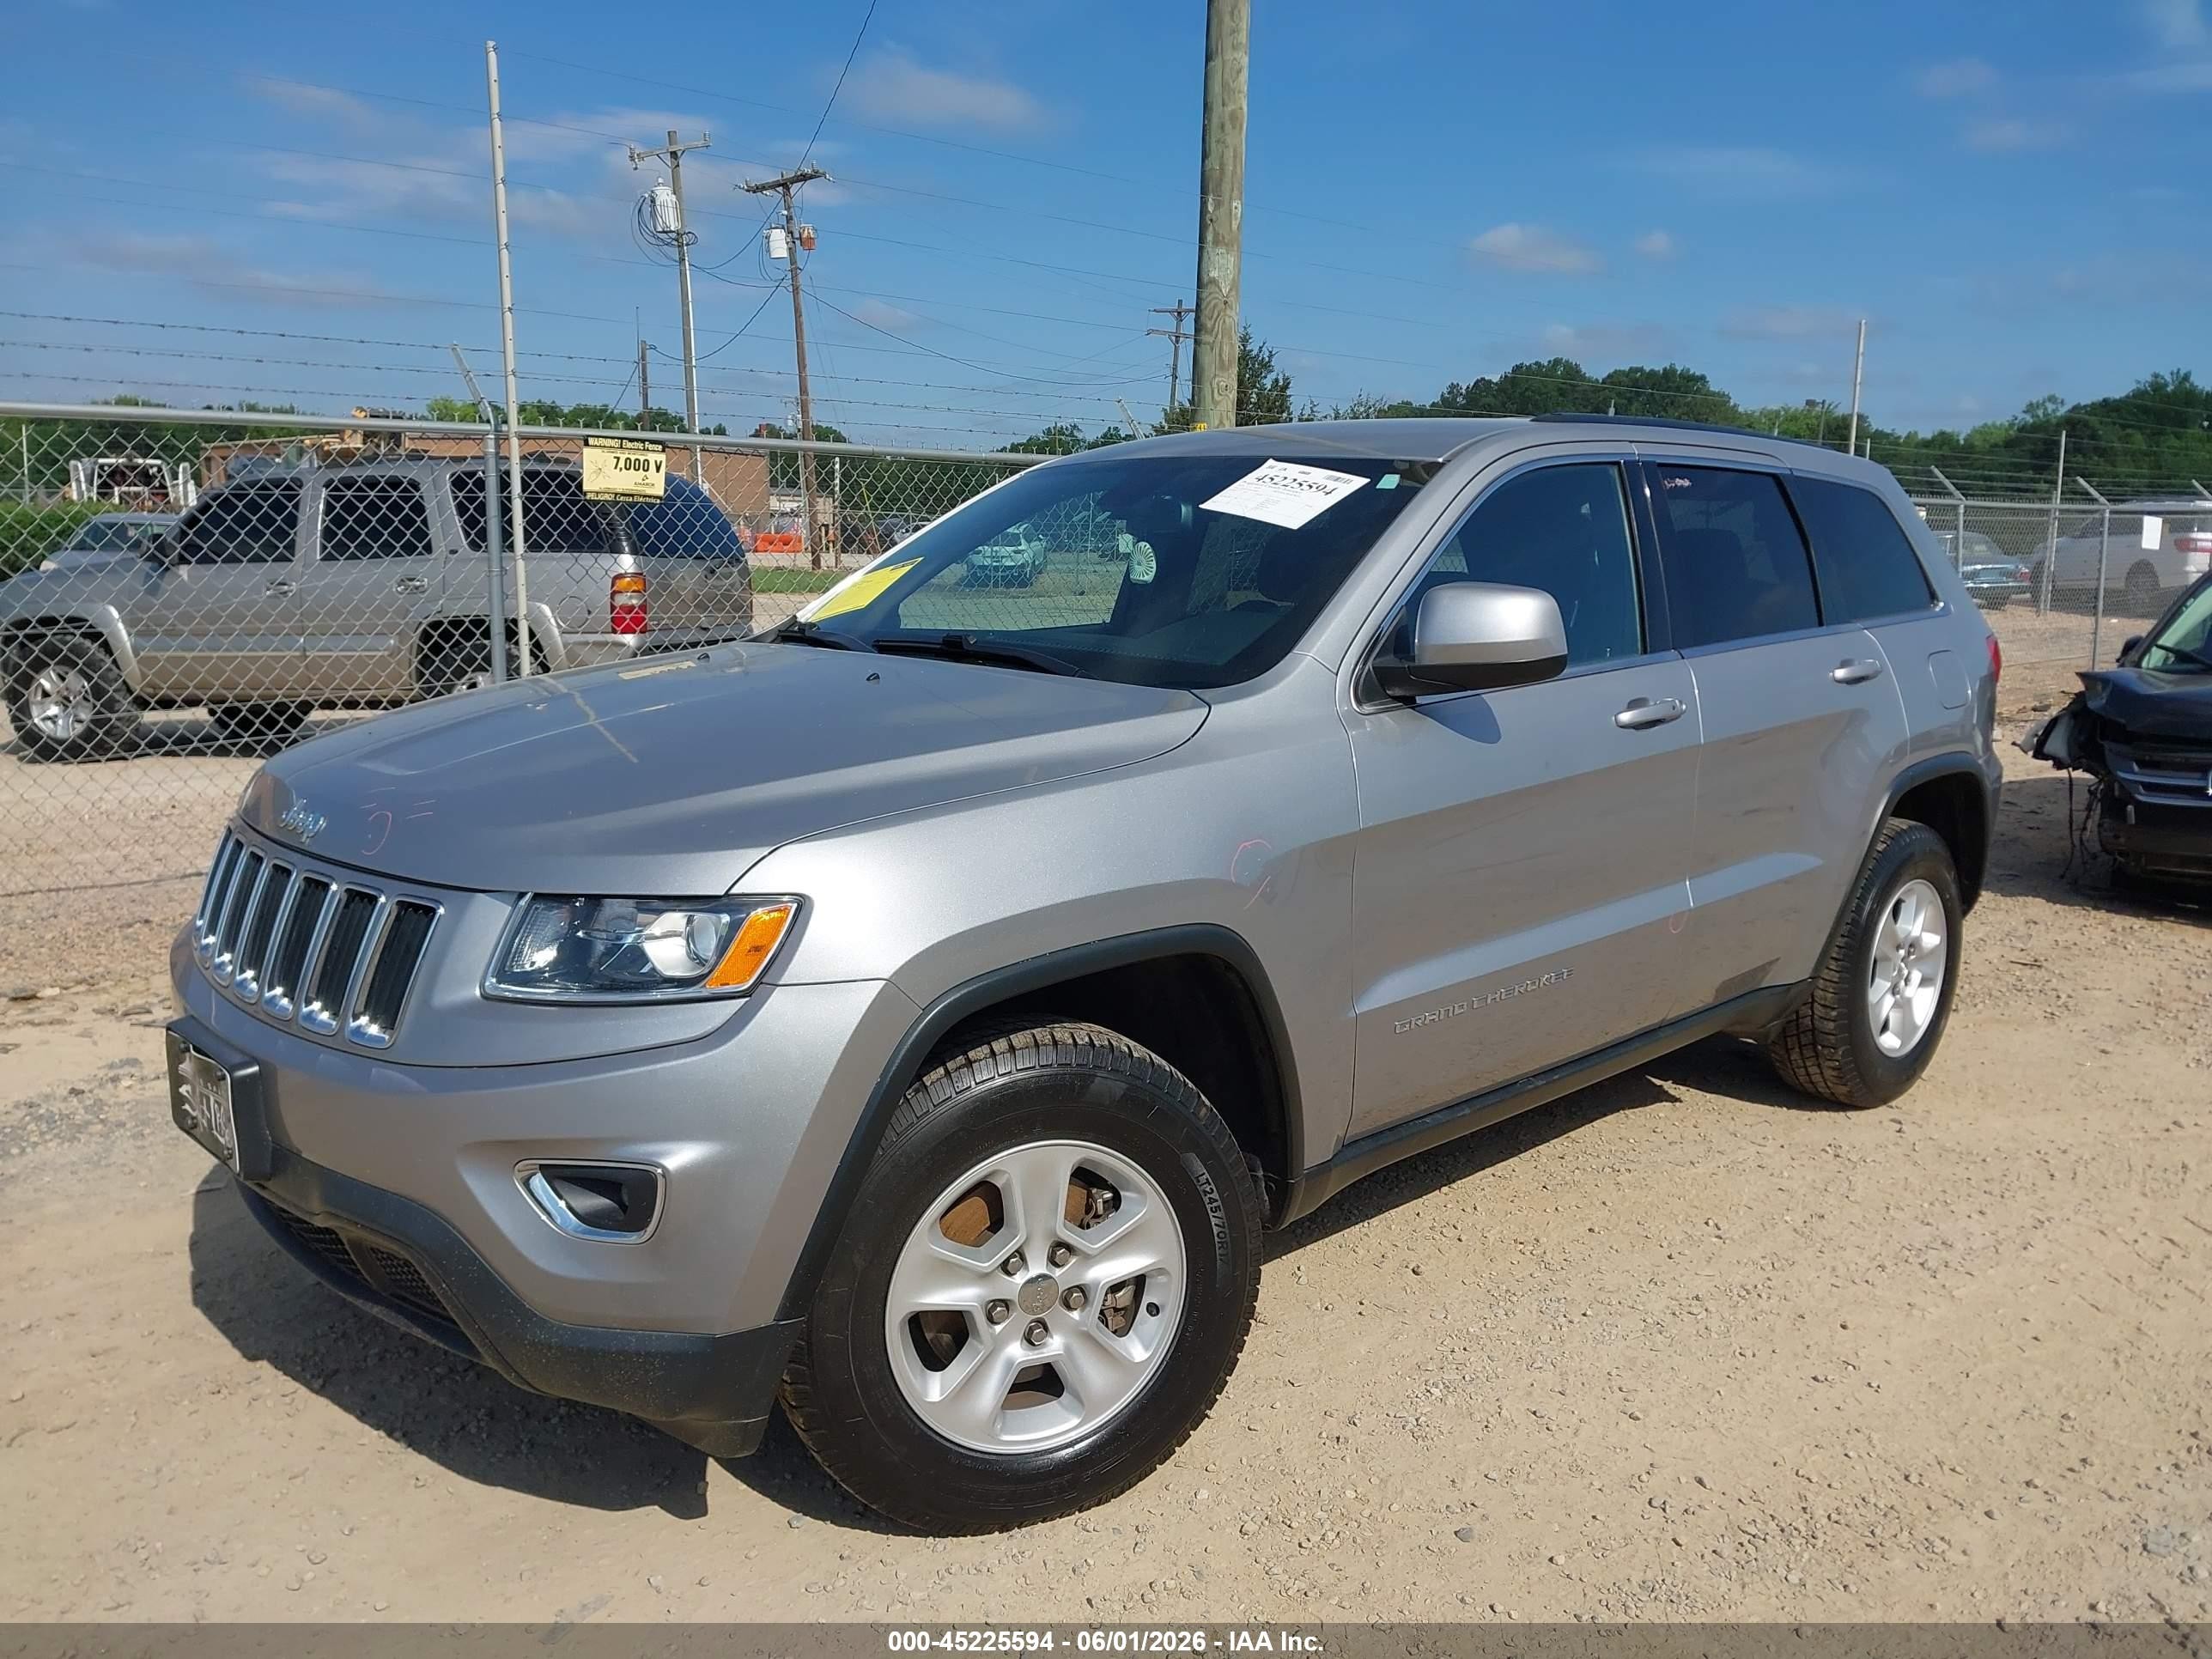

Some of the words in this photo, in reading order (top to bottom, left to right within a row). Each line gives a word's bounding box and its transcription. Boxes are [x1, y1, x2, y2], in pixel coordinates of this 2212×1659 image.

[588, 436, 621, 447] WARNING!
[623, 439, 644, 450] Electric
[645, 441, 663, 452] Fence
[613, 456, 650, 472] 7,000
[654, 459, 663, 473] V
[1255, 473, 1339, 496] 45225594
[279, 798, 327, 845] Jeep
[1394, 1002, 1468, 1034] GRAND
[1472, 967, 1575, 1010] CHEROKEE
